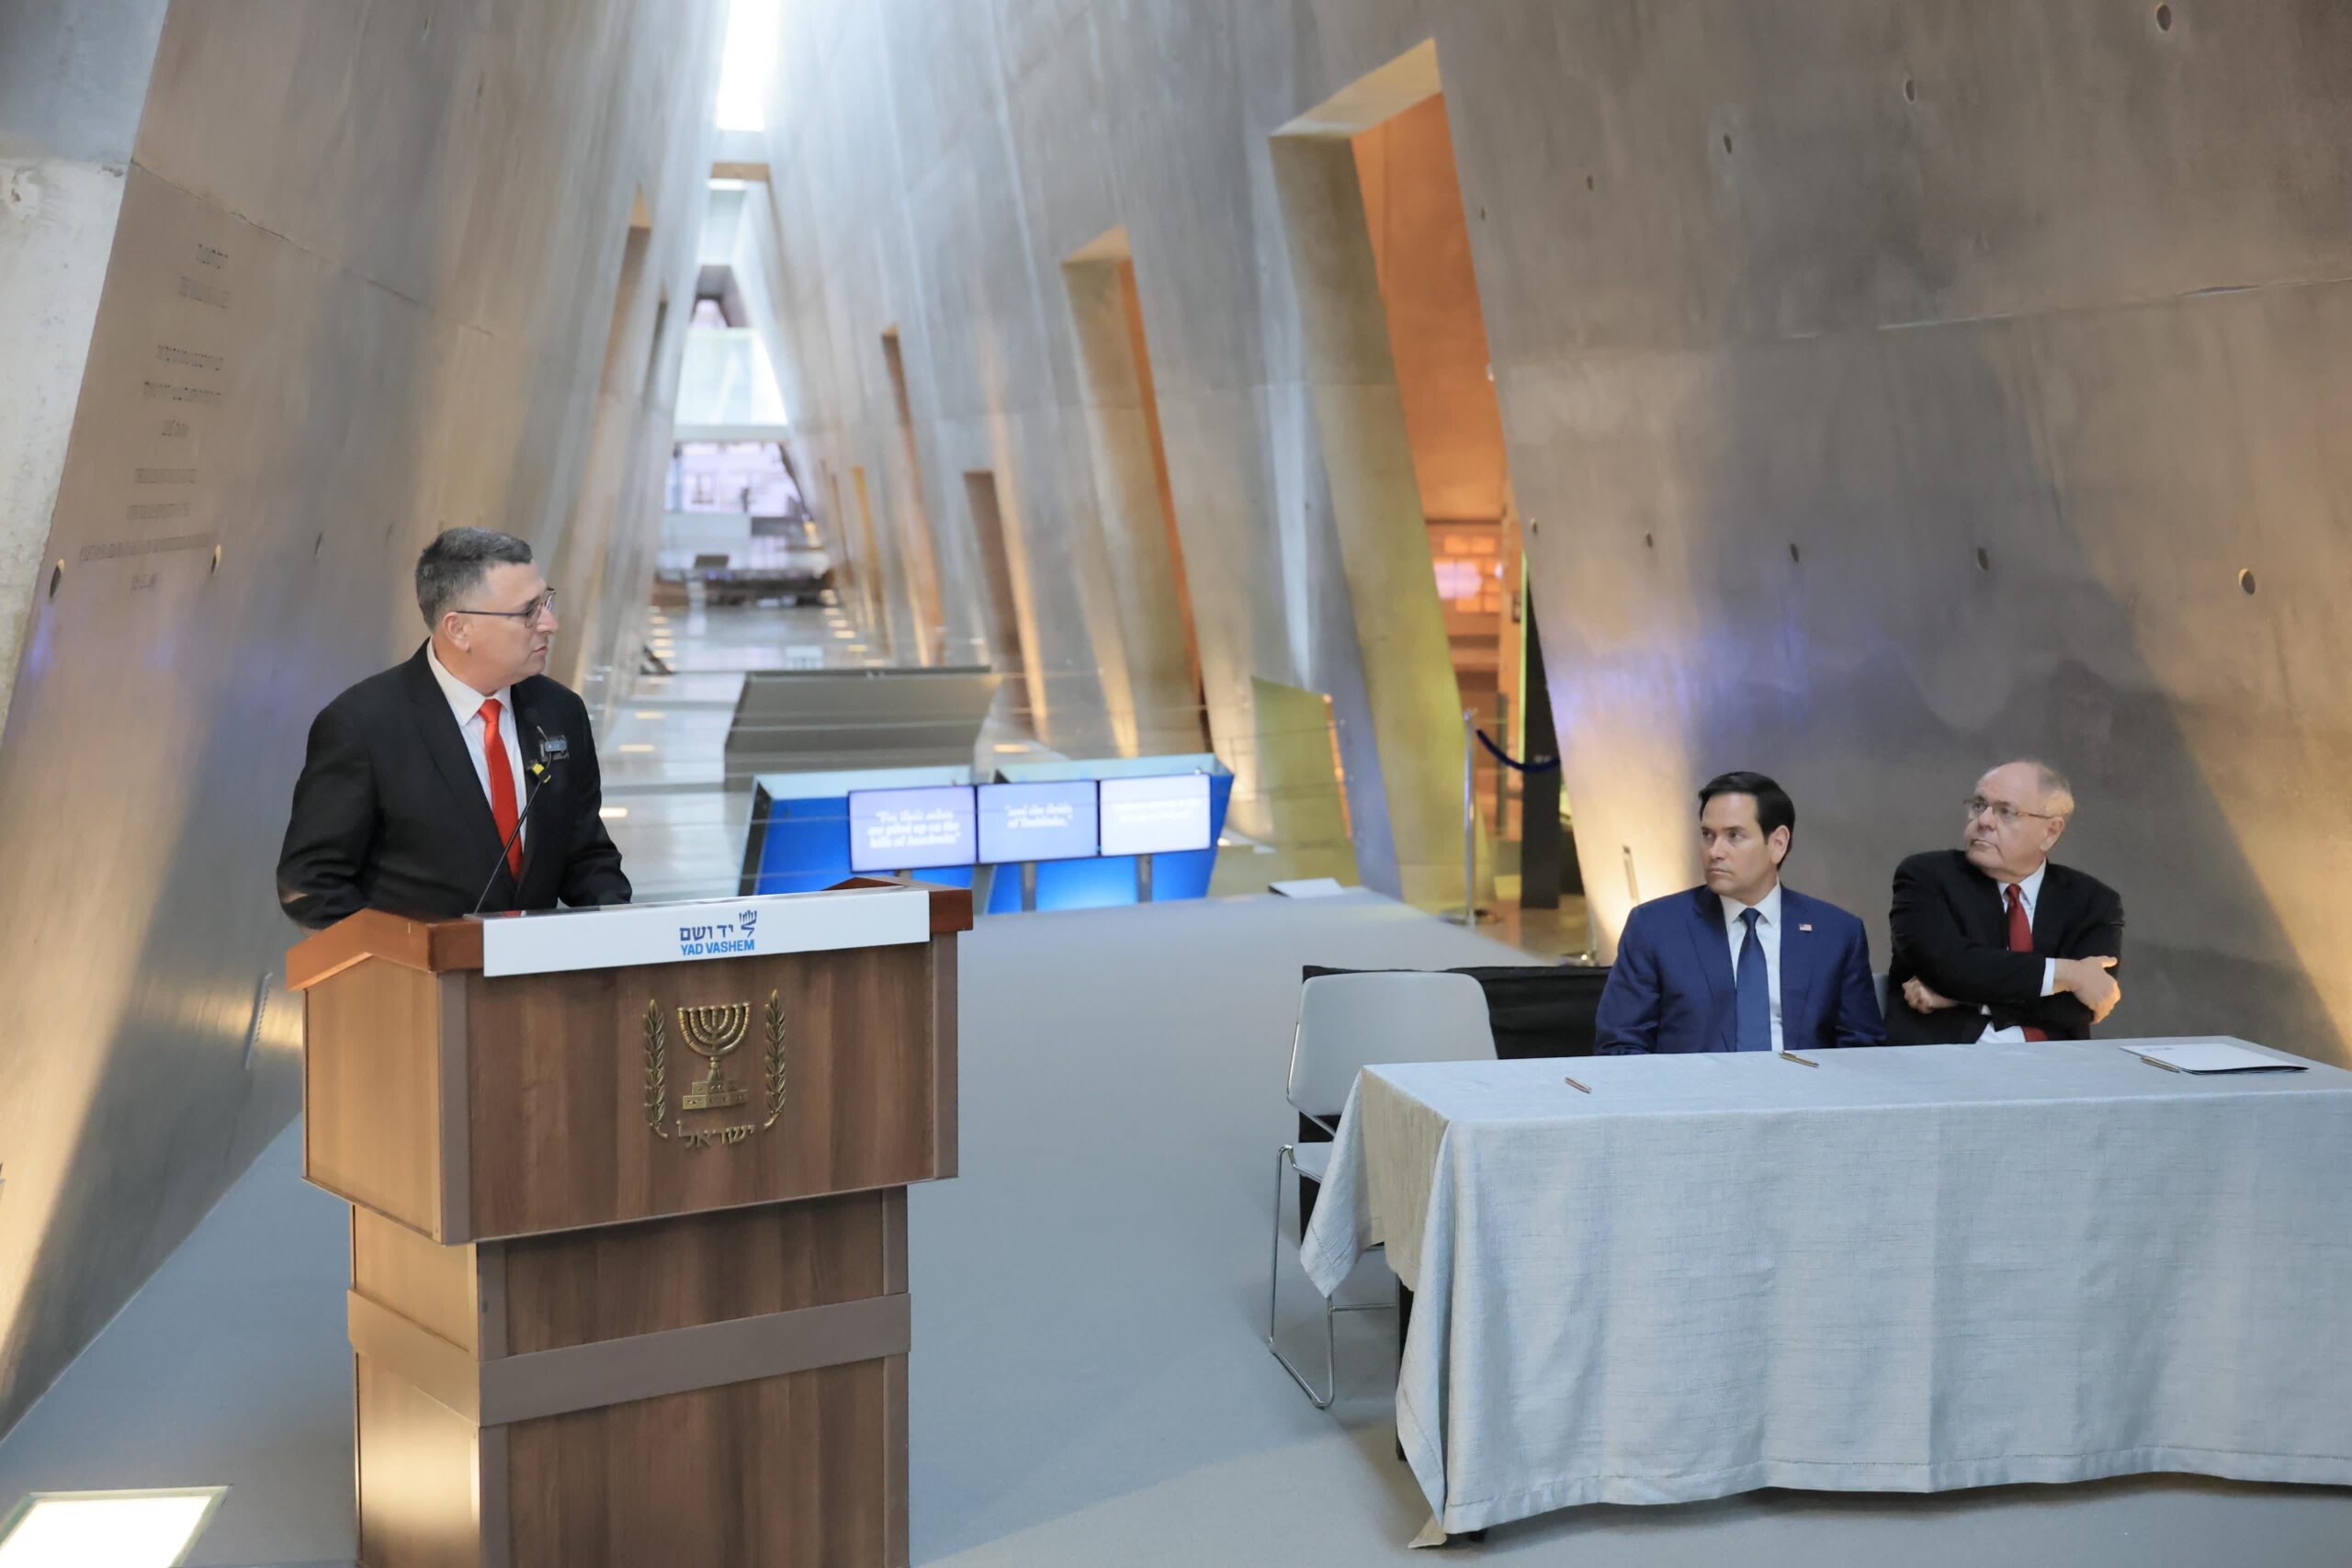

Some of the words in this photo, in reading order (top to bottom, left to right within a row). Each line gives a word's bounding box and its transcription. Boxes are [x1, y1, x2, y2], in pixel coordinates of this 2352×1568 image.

[680, 926, 713, 942] ושם
[717, 924, 734, 939] יד
[681, 943, 704, 955] YAD
[706, 939, 754, 954] VASHEM
[676, 1119, 755, 1148] ישראל
